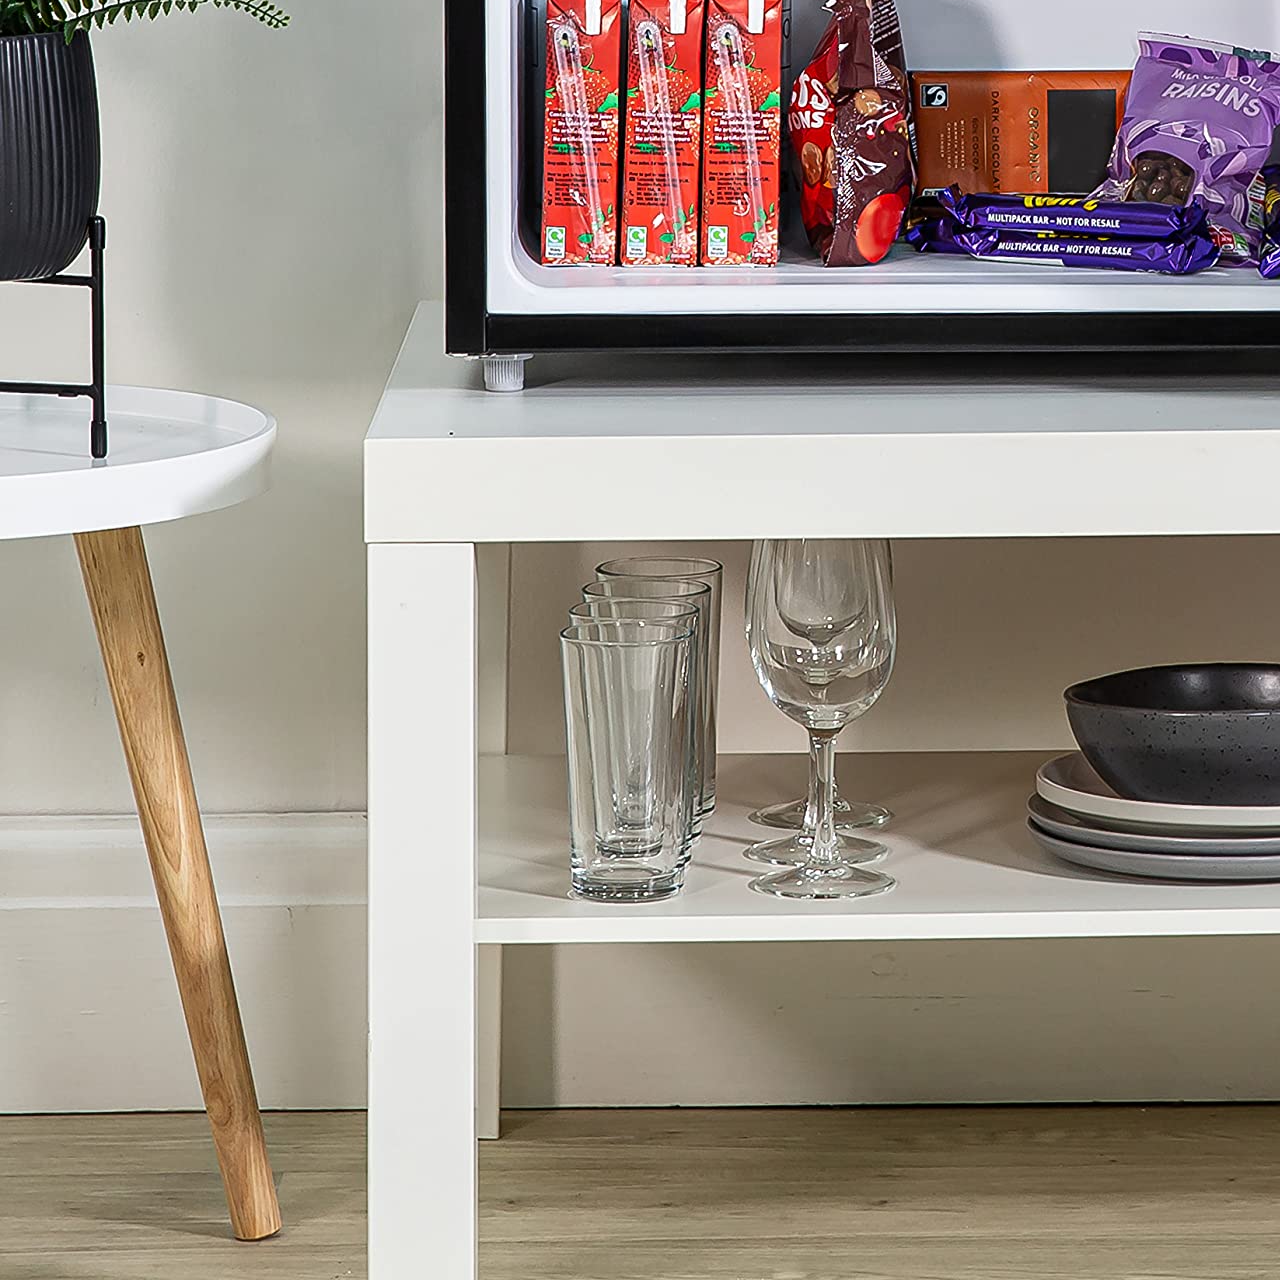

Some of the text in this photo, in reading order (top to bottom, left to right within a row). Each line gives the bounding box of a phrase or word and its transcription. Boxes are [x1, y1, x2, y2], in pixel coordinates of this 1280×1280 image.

[1161, 82, 1262, 117] RAISINS
[971, 135, 980, 172] COCOA
[991, 91, 1001, 194] DARK CHOCOLAT
[1028, 107, 1041, 183] ORGANIC
[987, 213, 1031, 224] MULTIPACK
[1032, 215, 1050, 225] BAR
[1056, 217, 1073, 227] NOT
[1073, 217, 1090, 227] FOR
[1091, 218, 1120, 228] RESALE
[997, 242, 1042, 252] MULTIPACK
[1042, 244, 1060, 253] BAR
[1066, 245, 1083, 254] NOT
[1084, 245, 1101, 255] FOR
[1101, 246, 1132, 256] RESALE
